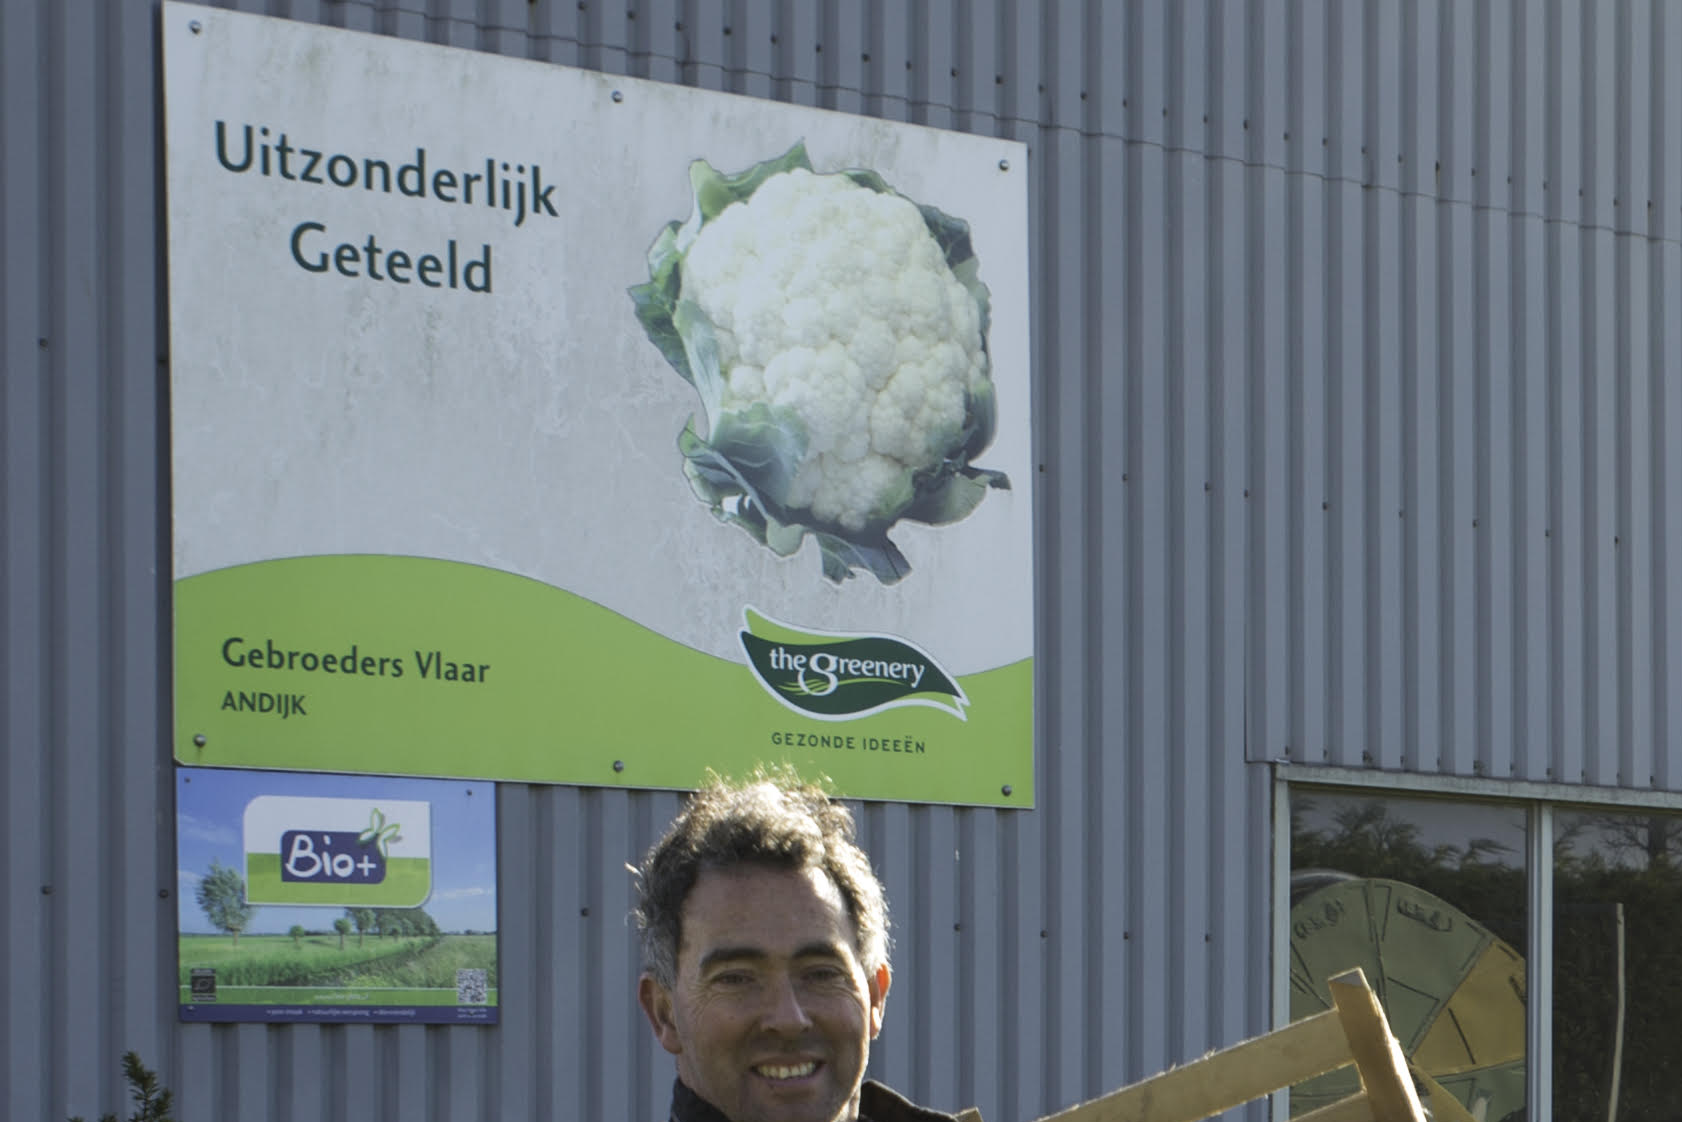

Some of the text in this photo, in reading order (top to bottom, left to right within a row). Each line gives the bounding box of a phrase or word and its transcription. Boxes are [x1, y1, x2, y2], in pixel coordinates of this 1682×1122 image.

[215, 120, 559, 227] Uitzonderlijk
[290, 221, 493, 293] Geteeld
[222, 637, 490, 683] Gebroeders Vlaar
[769, 647, 925, 696] the greenery
[221, 690, 307, 719] ANDIJK
[771, 732, 926, 753] GEZONDE IDEEËN
[285, 834, 377, 878] Bio+
